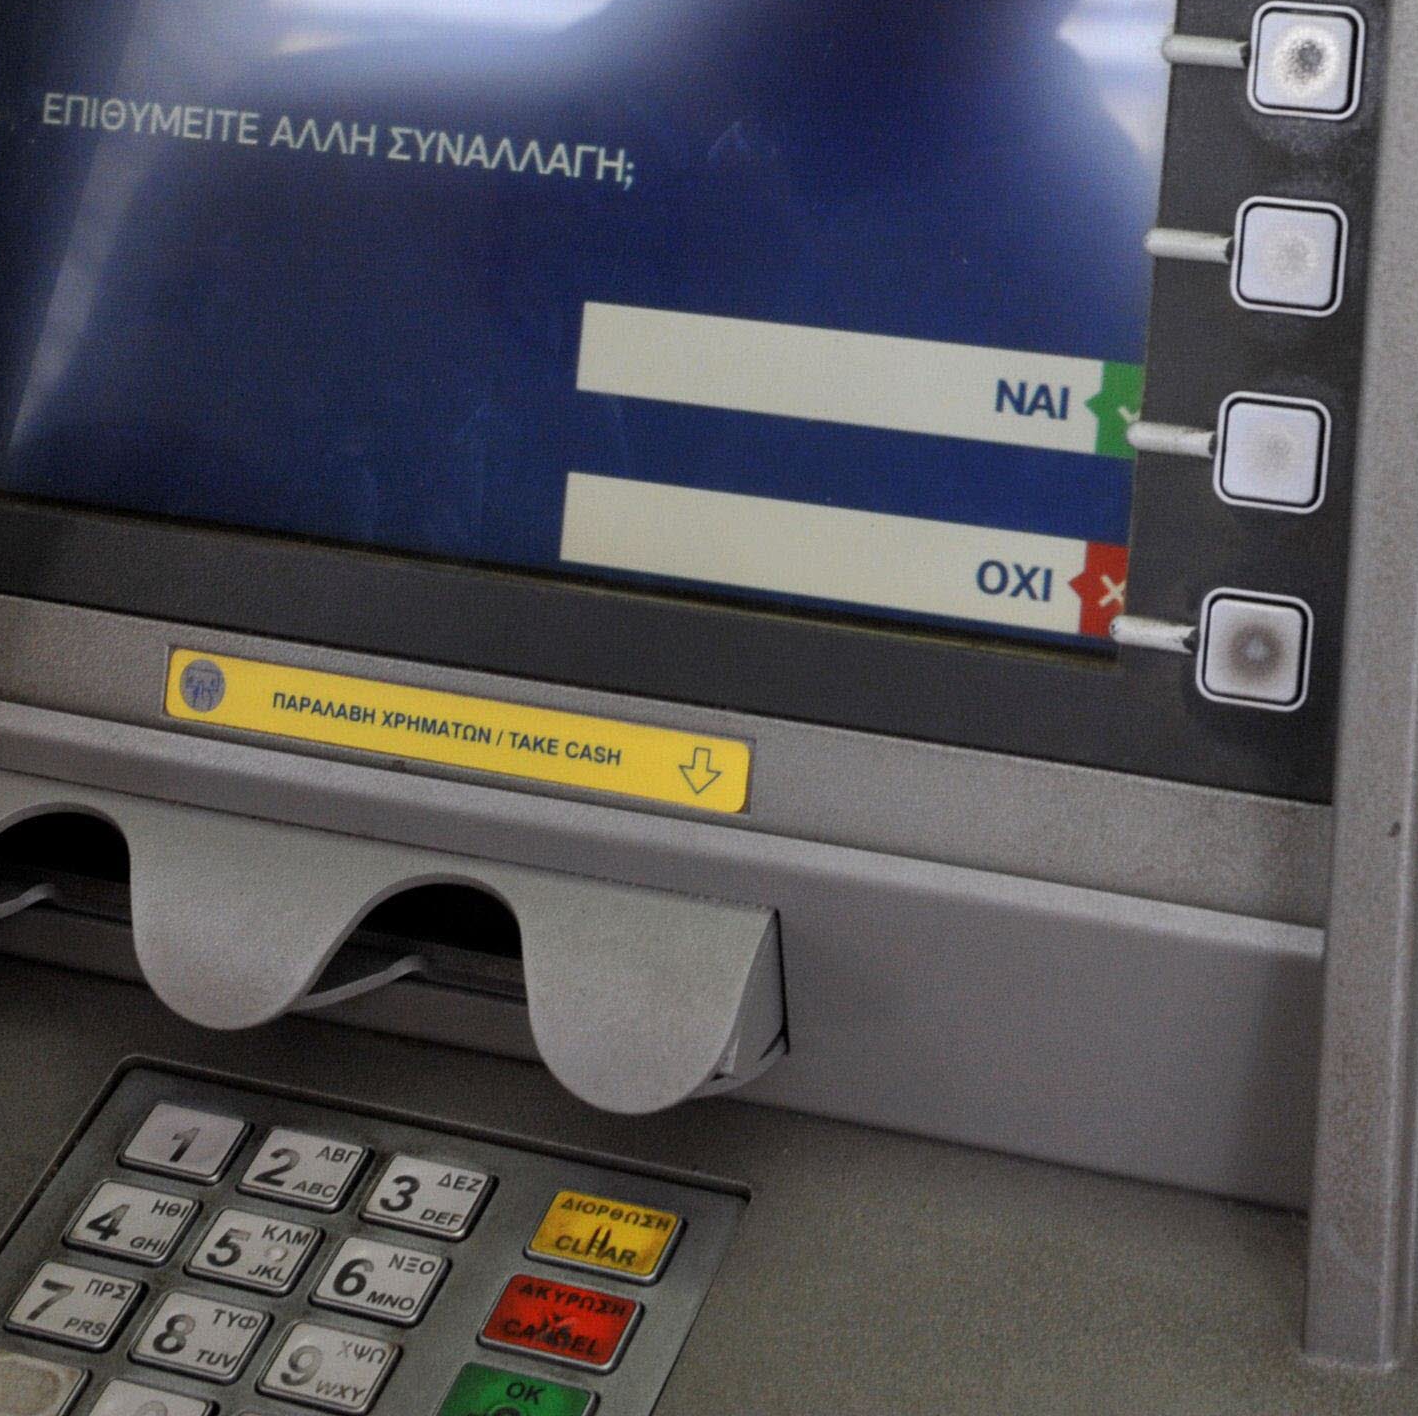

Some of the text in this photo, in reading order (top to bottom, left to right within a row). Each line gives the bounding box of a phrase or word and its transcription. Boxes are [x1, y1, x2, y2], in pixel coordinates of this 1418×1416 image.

[42, 92, 635, 190] ΕΠΙΘΥΜΕΙΤΕ ΑΛΛΗ ΣΥΝΑΛΛΑΓΗ;
[994, 378, 1071, 421] ΝΑΙ
[976, 559, 1053, 603] ΟΧΙ
[272, 692, 622, 766] ΠΑΡΑΛΑΒΗ ΧΡΗΜΑΤΩΝ / TAKE CASH
[168, 1126, 201, 1163] 1
[315, 1146, 360, 1165] ΑΒΓ
[253, 1148, 301, 1186] 2
[291, 1181, 338, 1198] ABC
[380, 1175, 421, 1212] 3
[437, 1173, 483, 1193] ΔΕΖ
[151, 1199, 189, 1219] ΗΘΙ
[420, 1208, 464, 1227] DEF
[560, 1197, 671, 1232] ΔΙΟΡΘΩΣΗ
[86, 1203, 131, 1242] 4
[130, 1236, 167, 1254] GHI
[261, 1224, 311, 1246] ΚΛΜ
[206, 1228, 252, 1268] 5
[248, 1264, 285, 1282] JKL
[388, 1254, 436, 1275] ΝΞΟ
[84, 1278, 132, 1300] ΠΡΣ
[332, 1258, 374, 1297] 6
[27, 1278, 74, 1321] 7
[366, 1290, 415, 1311] MNO
[64, 1318, 107, 1335] PRS
[213, 1308, 259, 1330] ΤΥΦ
[152, 1314, 196, 1354] 8
[195, 1349, 238, 1368] TUV
[281, 1345, 323, 1387] 9
[315, 1380, 366, 1402] WXY
[506, 1381, 544, 1405] OK
